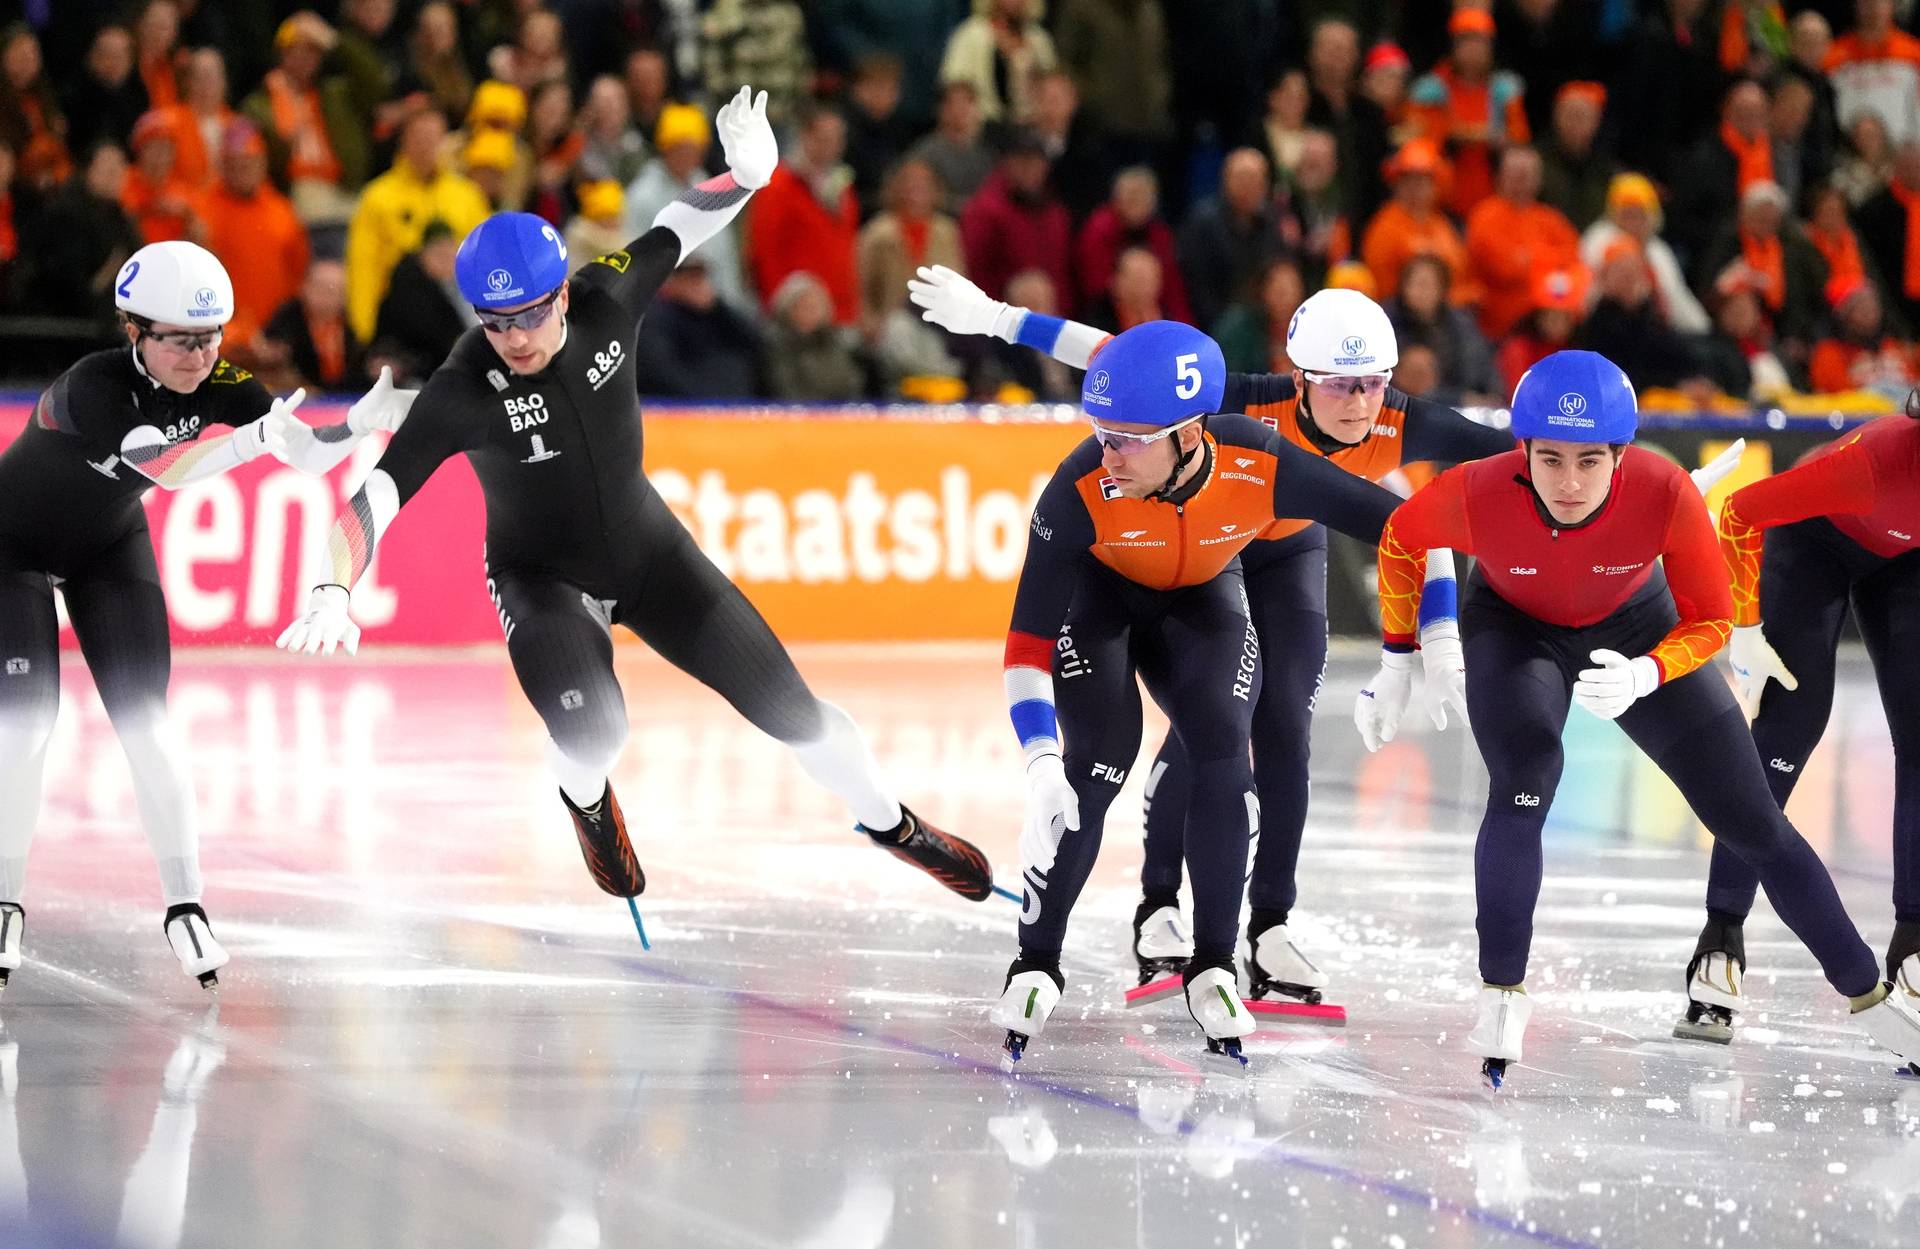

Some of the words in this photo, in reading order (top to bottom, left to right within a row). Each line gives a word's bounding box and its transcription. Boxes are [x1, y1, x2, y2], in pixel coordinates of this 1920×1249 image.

[541, 225, 567, 261] 2
[118, 261, 140, 298] 2
[586, 340, 621, 384] a&o
[1175, 353, 1202, 400] 5
[504, 393, 544, 416] B&O
[510, 407, 549, 433] BAU
[1547, 415, 1595, 424] INTERNATIONAL
[1548, 419, 1574, 427] SKATING
[1220, 471, 1265, 486] REGGEBORGH
[162, 435, 398, 632] ent
[646, 464, 1054, 584] taatslo
[1510, 566, 1537, 575] d&a
[1091, 762, 1125, 784] FILA
[1770, 757, 1795, 773] d&a
[1514, 792, 1540, 807] d&a
